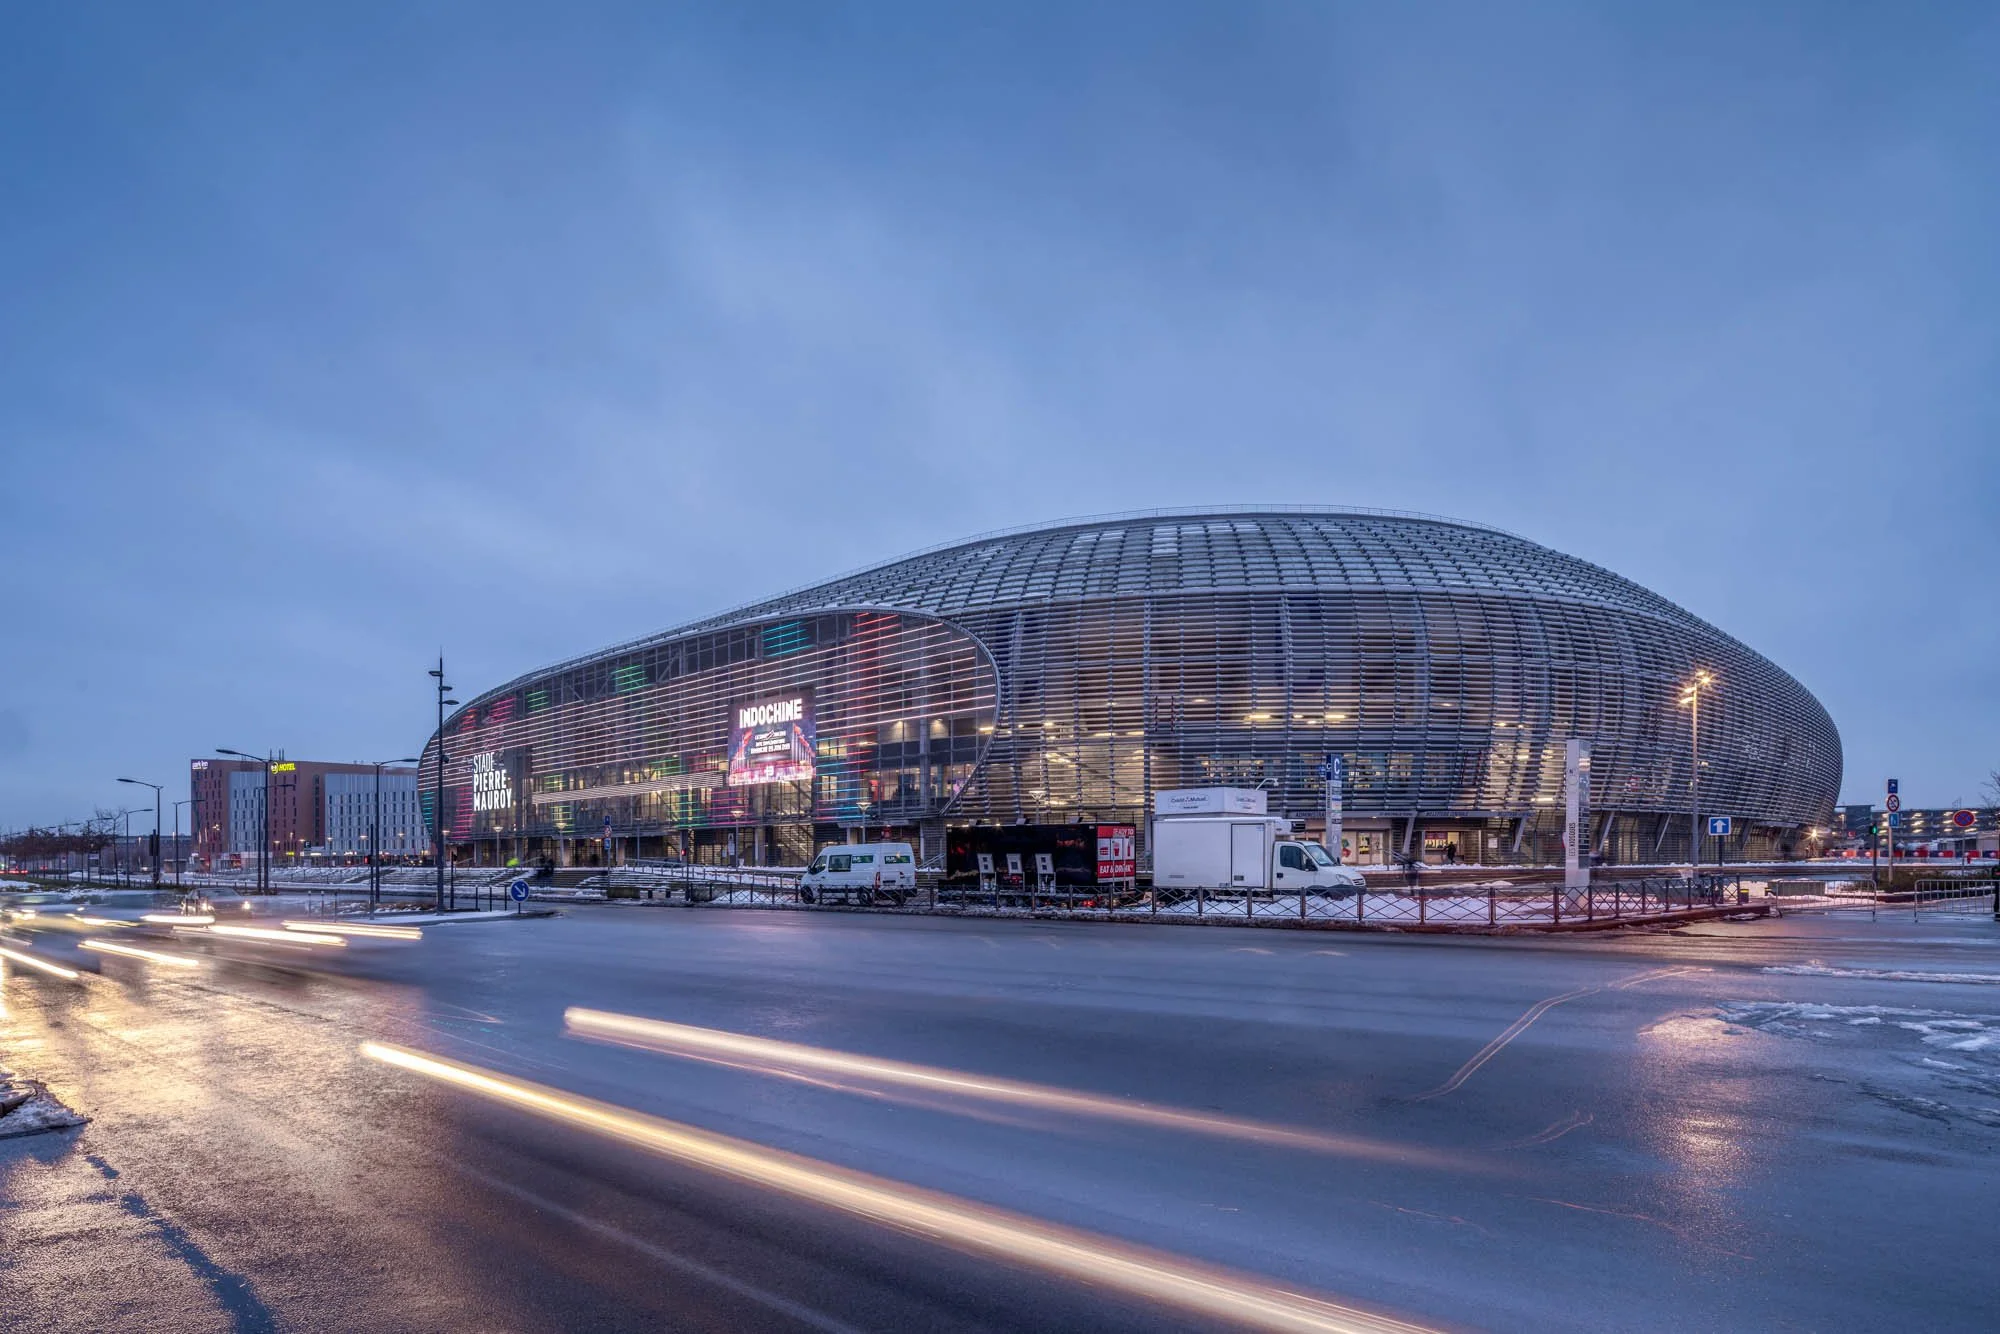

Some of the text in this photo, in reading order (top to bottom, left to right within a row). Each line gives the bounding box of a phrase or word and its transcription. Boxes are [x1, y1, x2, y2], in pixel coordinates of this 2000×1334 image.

[739, 698, 803, 729] INDOCHINE
[279, 763, 296, 772] HOTEL
[473, 752, 495, 773] STADE
[1334, 758, 1340, 775] C
[473, 788, 512, 811] MAUROY
[1100, 865, 1109, 873] EAT
